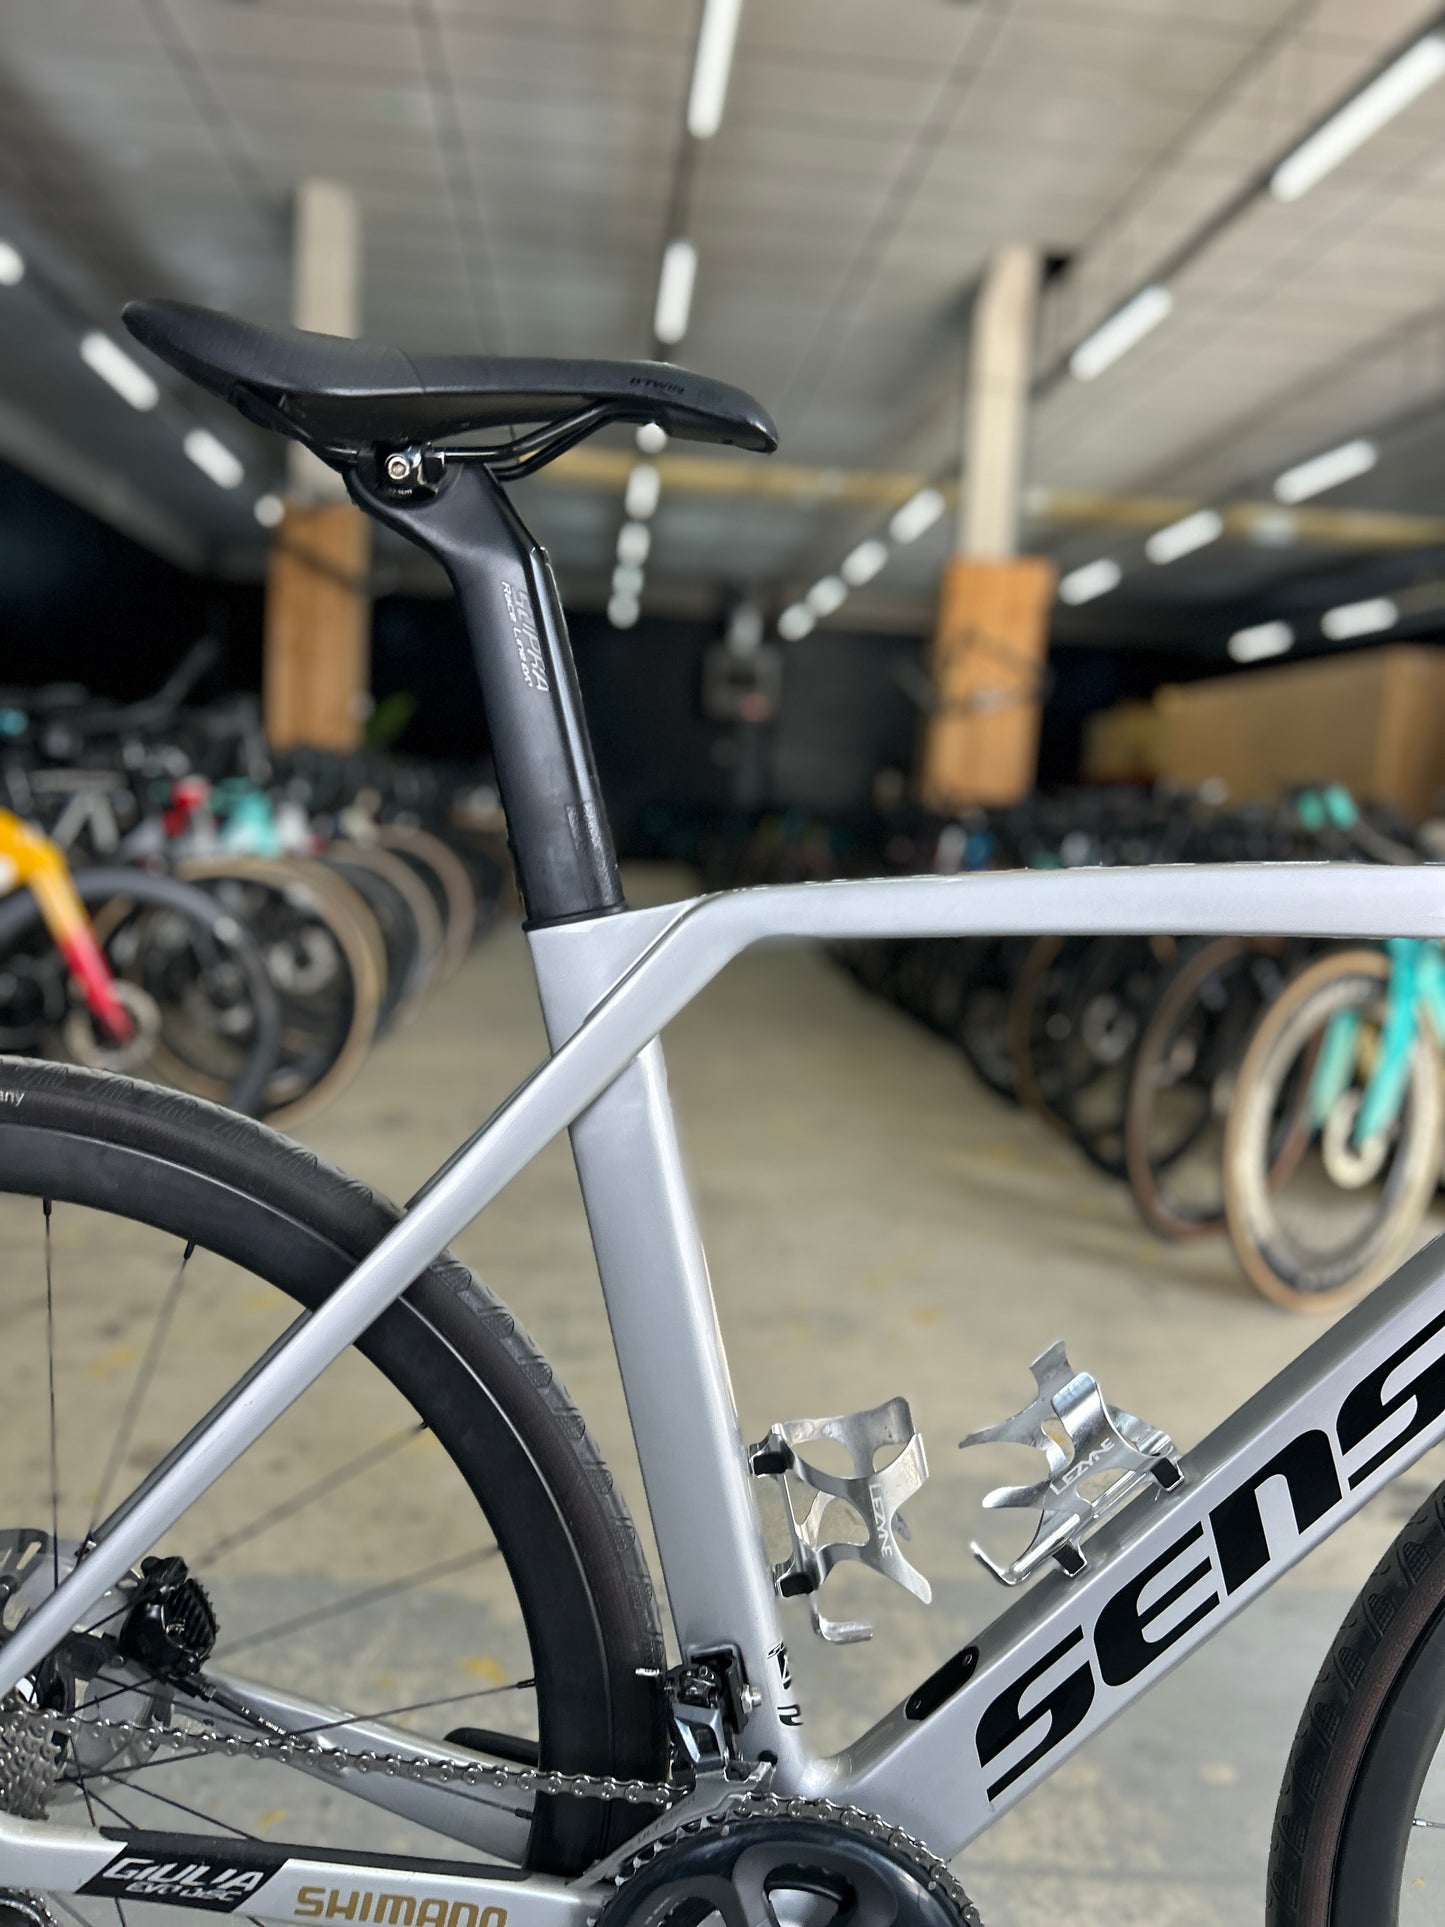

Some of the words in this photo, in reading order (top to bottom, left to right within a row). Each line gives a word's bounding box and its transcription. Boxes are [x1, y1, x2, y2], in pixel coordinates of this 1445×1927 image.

[512, 586, 550, 692] SUPRA
[1049, 1437, 1116, 1496] LEZYNE
[869, 1483, 893, 1558] LEZYNE
[102, 1857, 264, 1892] GIULIA
[294, 1886, 508, 1927] SHIMANO
